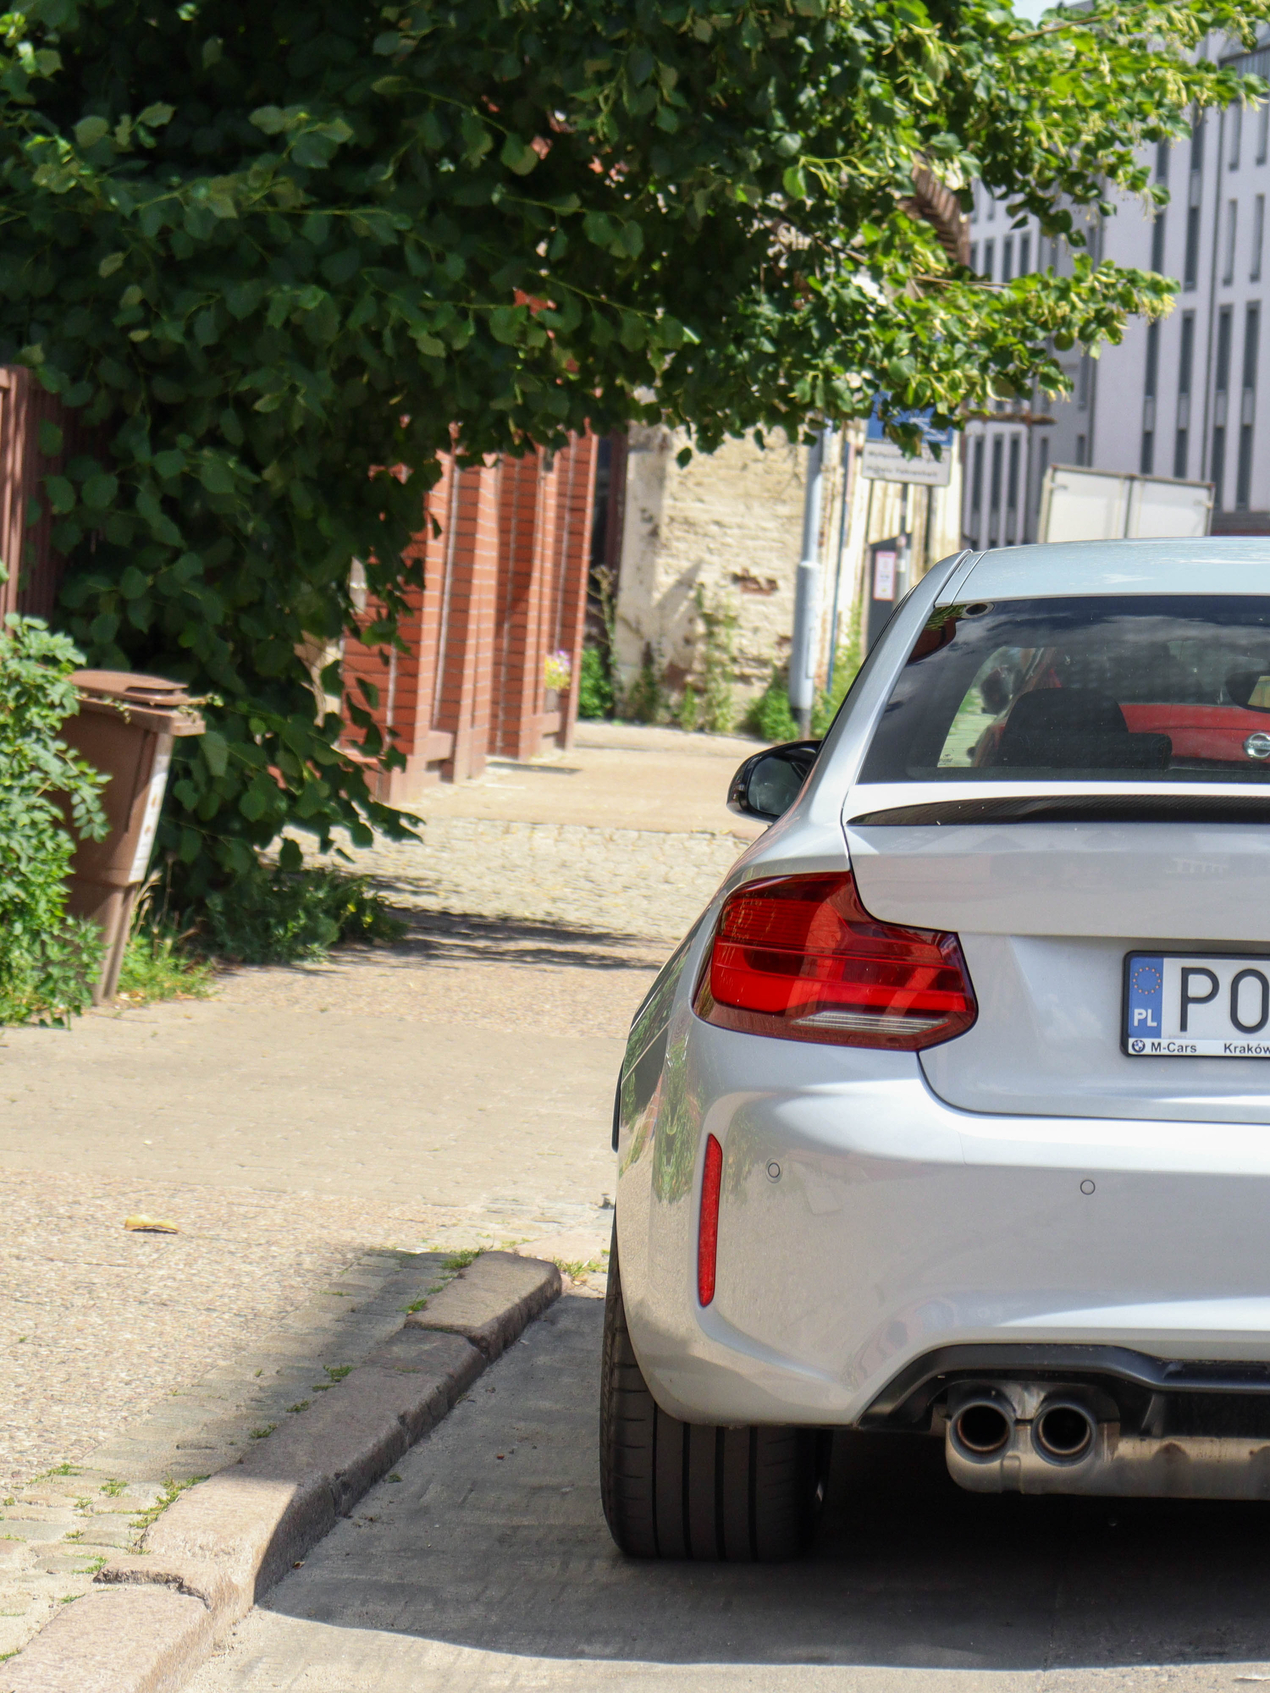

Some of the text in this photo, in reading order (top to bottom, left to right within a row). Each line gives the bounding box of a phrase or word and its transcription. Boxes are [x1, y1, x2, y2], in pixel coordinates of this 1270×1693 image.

[1180, 967, 1269, 1034] PO
[1133, 1008, 1158, 1028] PL
[1150, 1041, 1197, 1054] M-Cars
